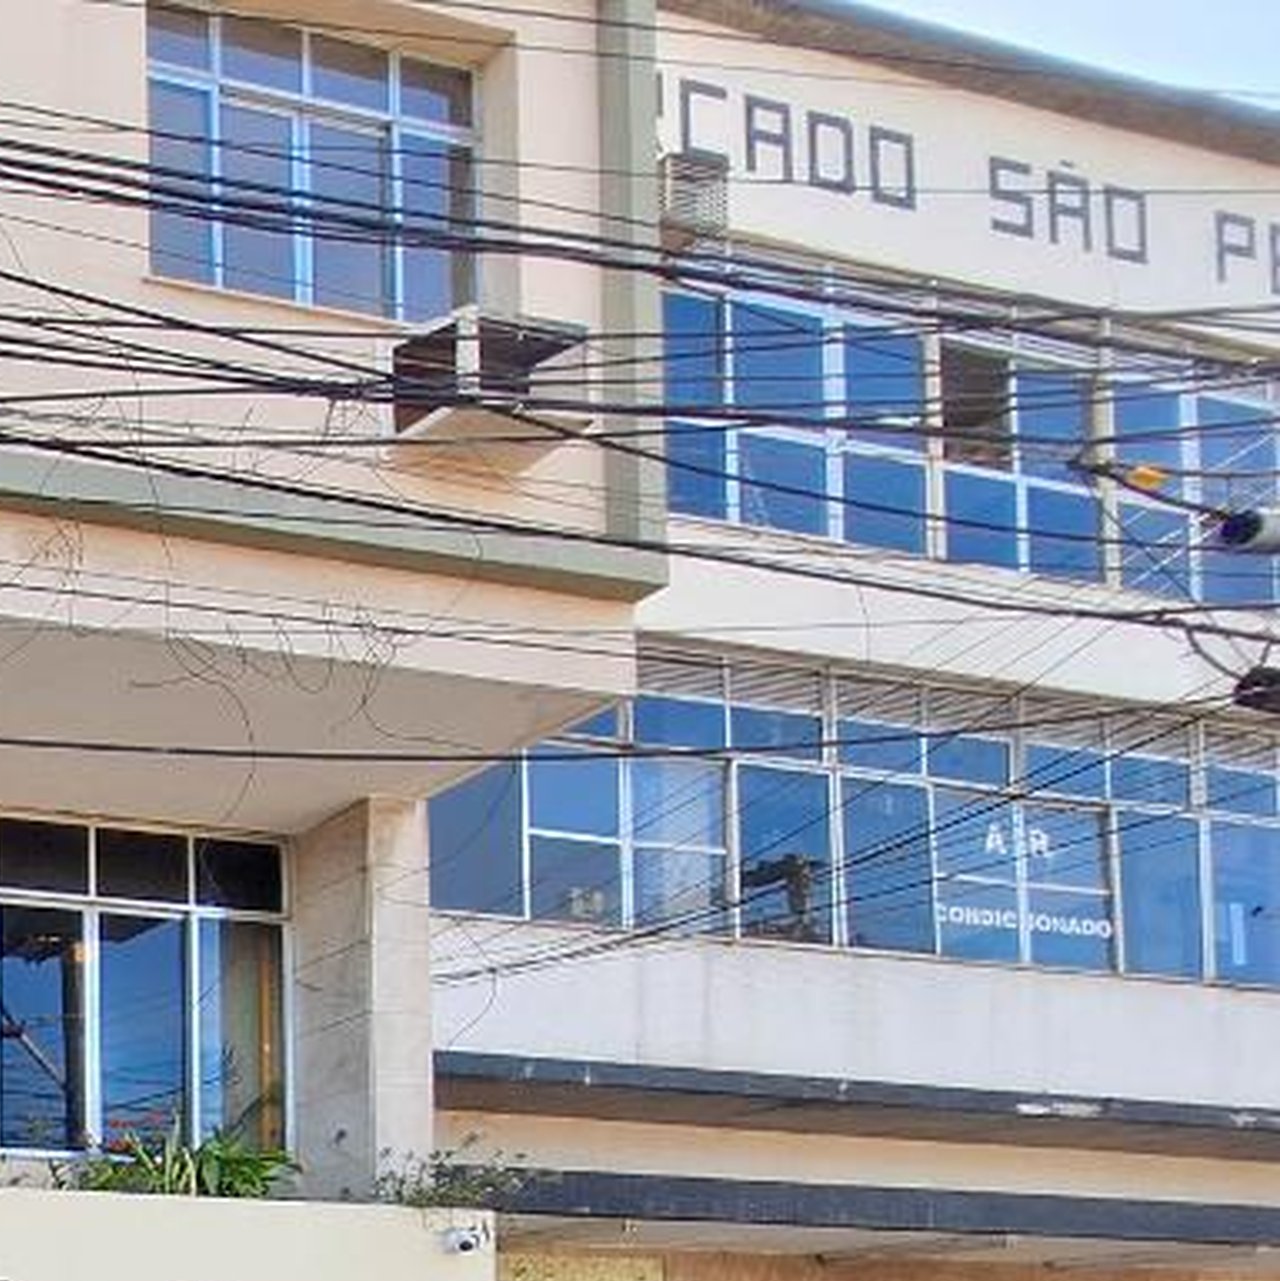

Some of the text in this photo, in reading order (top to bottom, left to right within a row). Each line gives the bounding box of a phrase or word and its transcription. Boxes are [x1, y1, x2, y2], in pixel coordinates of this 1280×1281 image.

[657, 72, 1280, 296] CADO SÃO P
[934, 902, 1113, 939] CONDICIONADO
